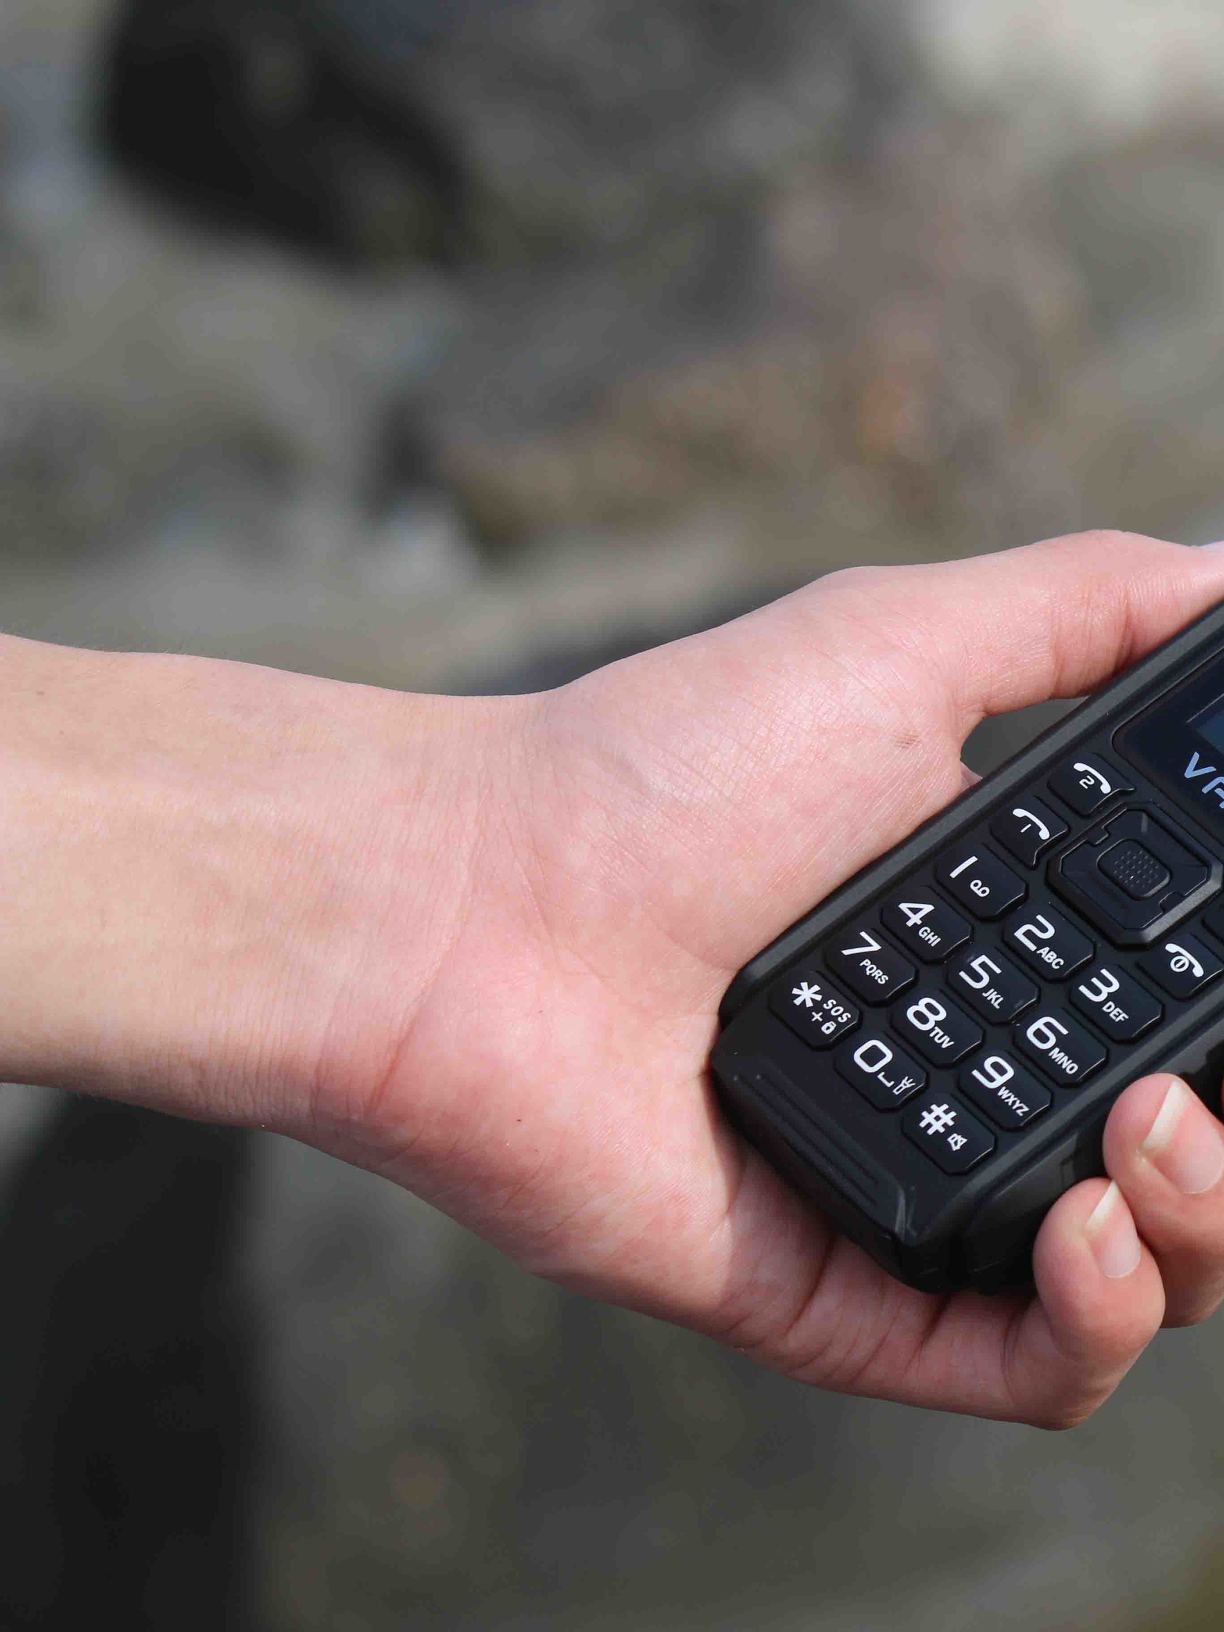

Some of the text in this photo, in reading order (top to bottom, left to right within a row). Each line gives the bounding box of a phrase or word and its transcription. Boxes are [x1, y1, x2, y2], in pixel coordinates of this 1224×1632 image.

[898, 902, 942, 946] 4 GHI
[1014, 914, 1064, 969] 2 ABC
[841, 931, 889, 984] 7 PQRS
[959, 954, 1003, 1009] 5 JKL
[823, 999, 851, 1023] SOS
[906, 997, 954, 1048] 8 TUV
[1078, 969, 1129, 1023] 3 DEF
[1026, 1016, 1079, 1075] 6 MNO
[971, 1056, 1030, 1116] 9 WXYZ
